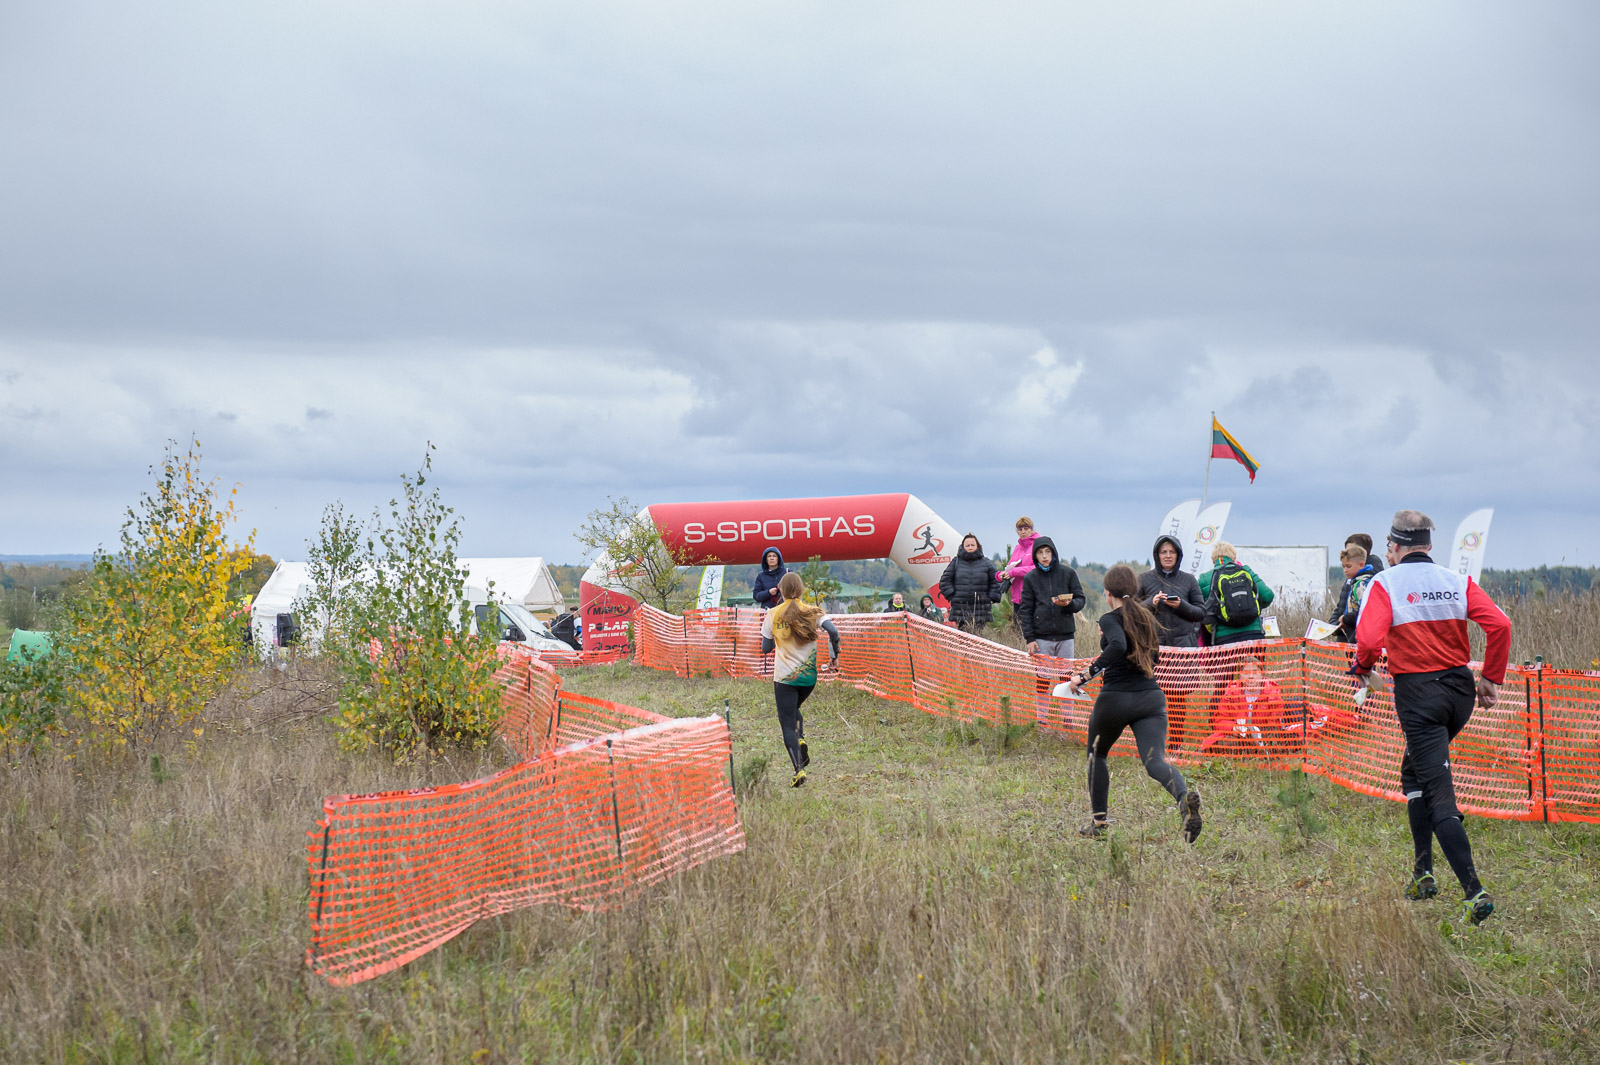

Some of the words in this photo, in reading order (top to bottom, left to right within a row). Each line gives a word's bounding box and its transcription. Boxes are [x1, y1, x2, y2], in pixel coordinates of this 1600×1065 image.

[684, 514, 876, 544] S-SPORTAS
[909, 556, 950, 564] S-SPORTAS
[1422, 591, 1459, 602] PAROC
[593, 604, 625, 616] MAVIC
[588, 620, 630, 632] POLAR
